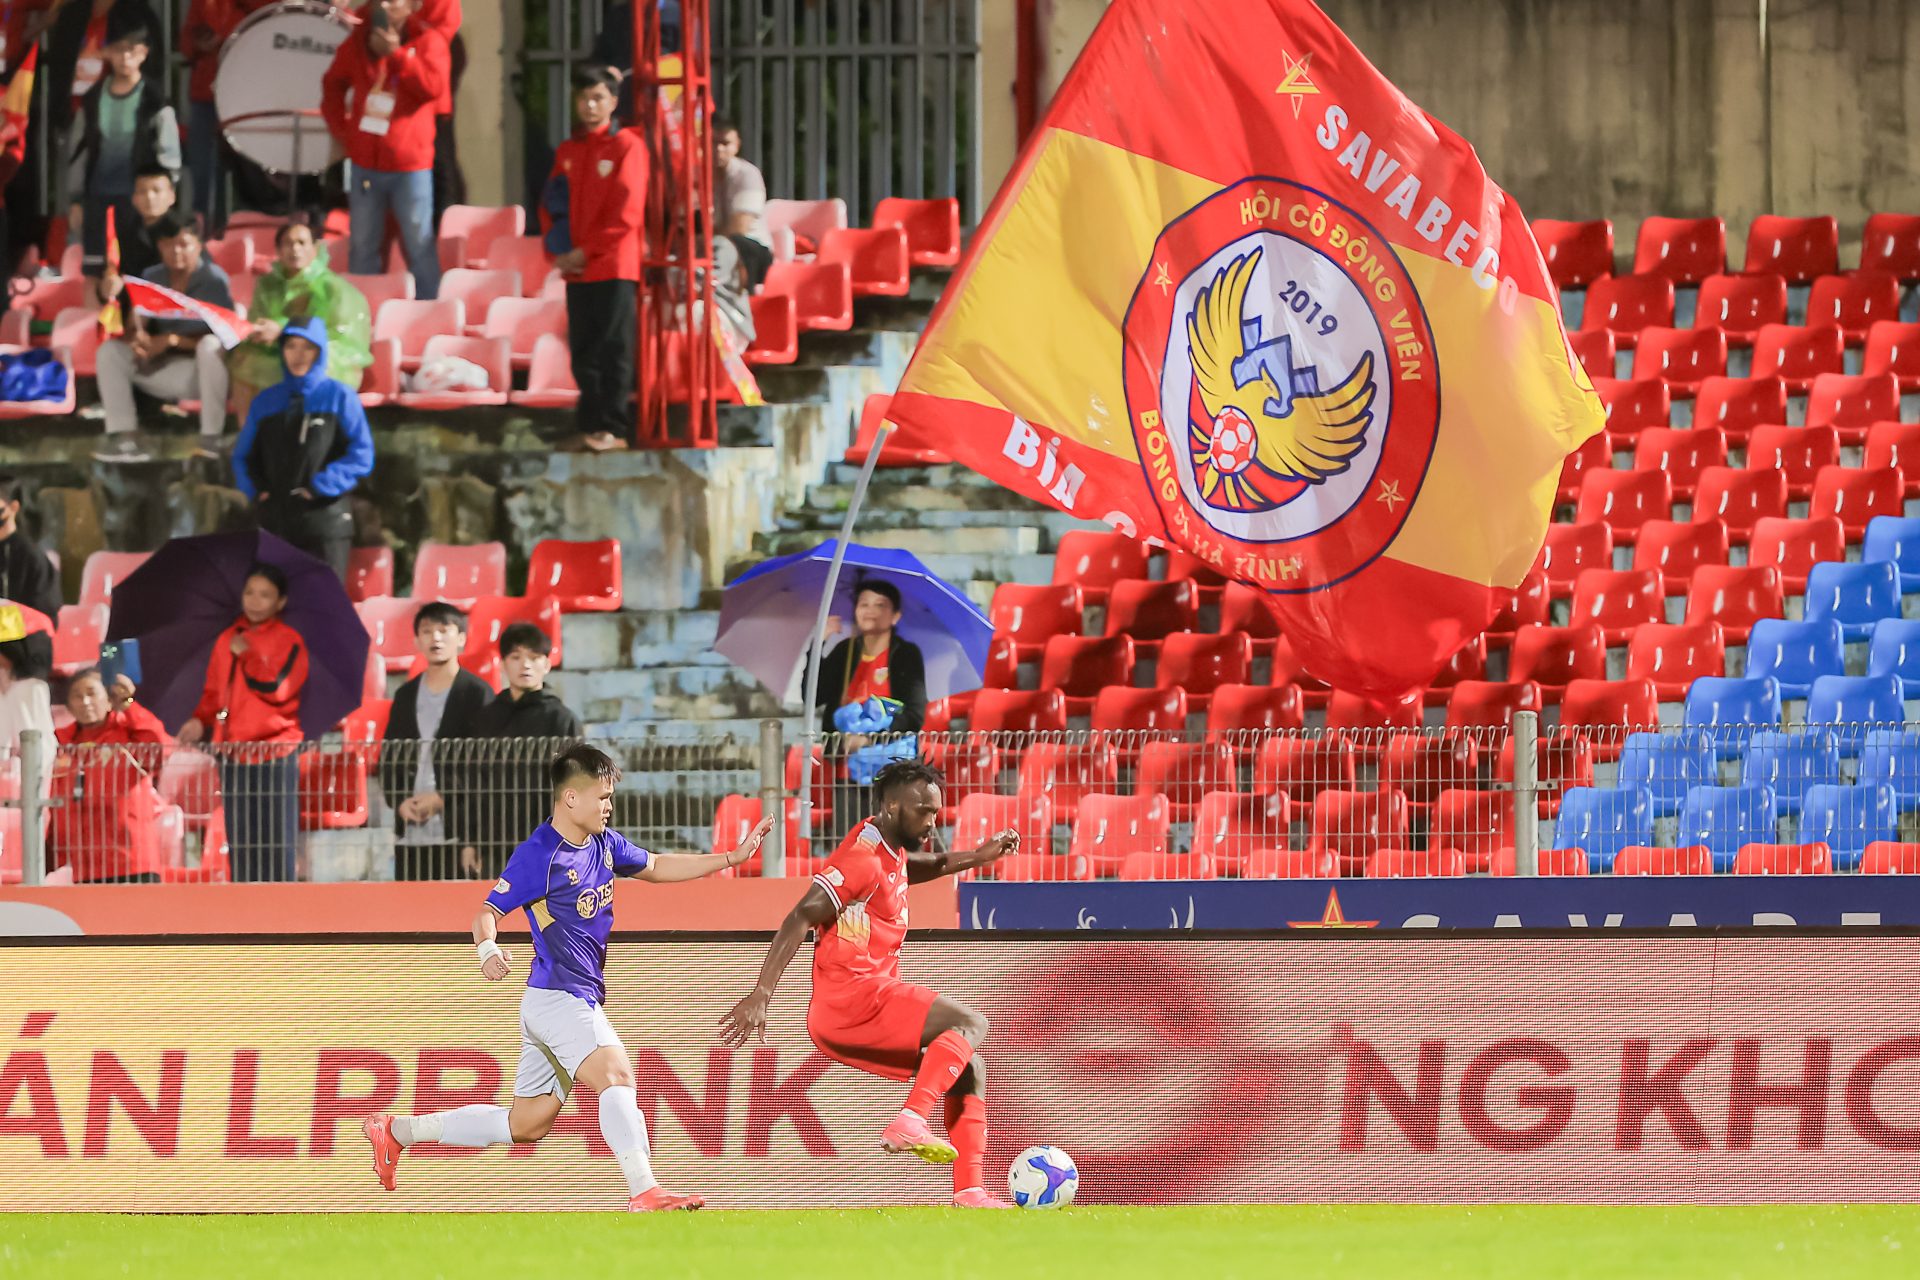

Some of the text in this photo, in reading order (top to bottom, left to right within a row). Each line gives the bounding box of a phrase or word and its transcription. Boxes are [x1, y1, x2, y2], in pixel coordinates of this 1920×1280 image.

[1239, 188, 1424, 381] HỘI CỔ ĐỘNG VIÊN
[1278, 279, 1339, 337] 2019
[1139, 409, 1178, 502] BÓNG
